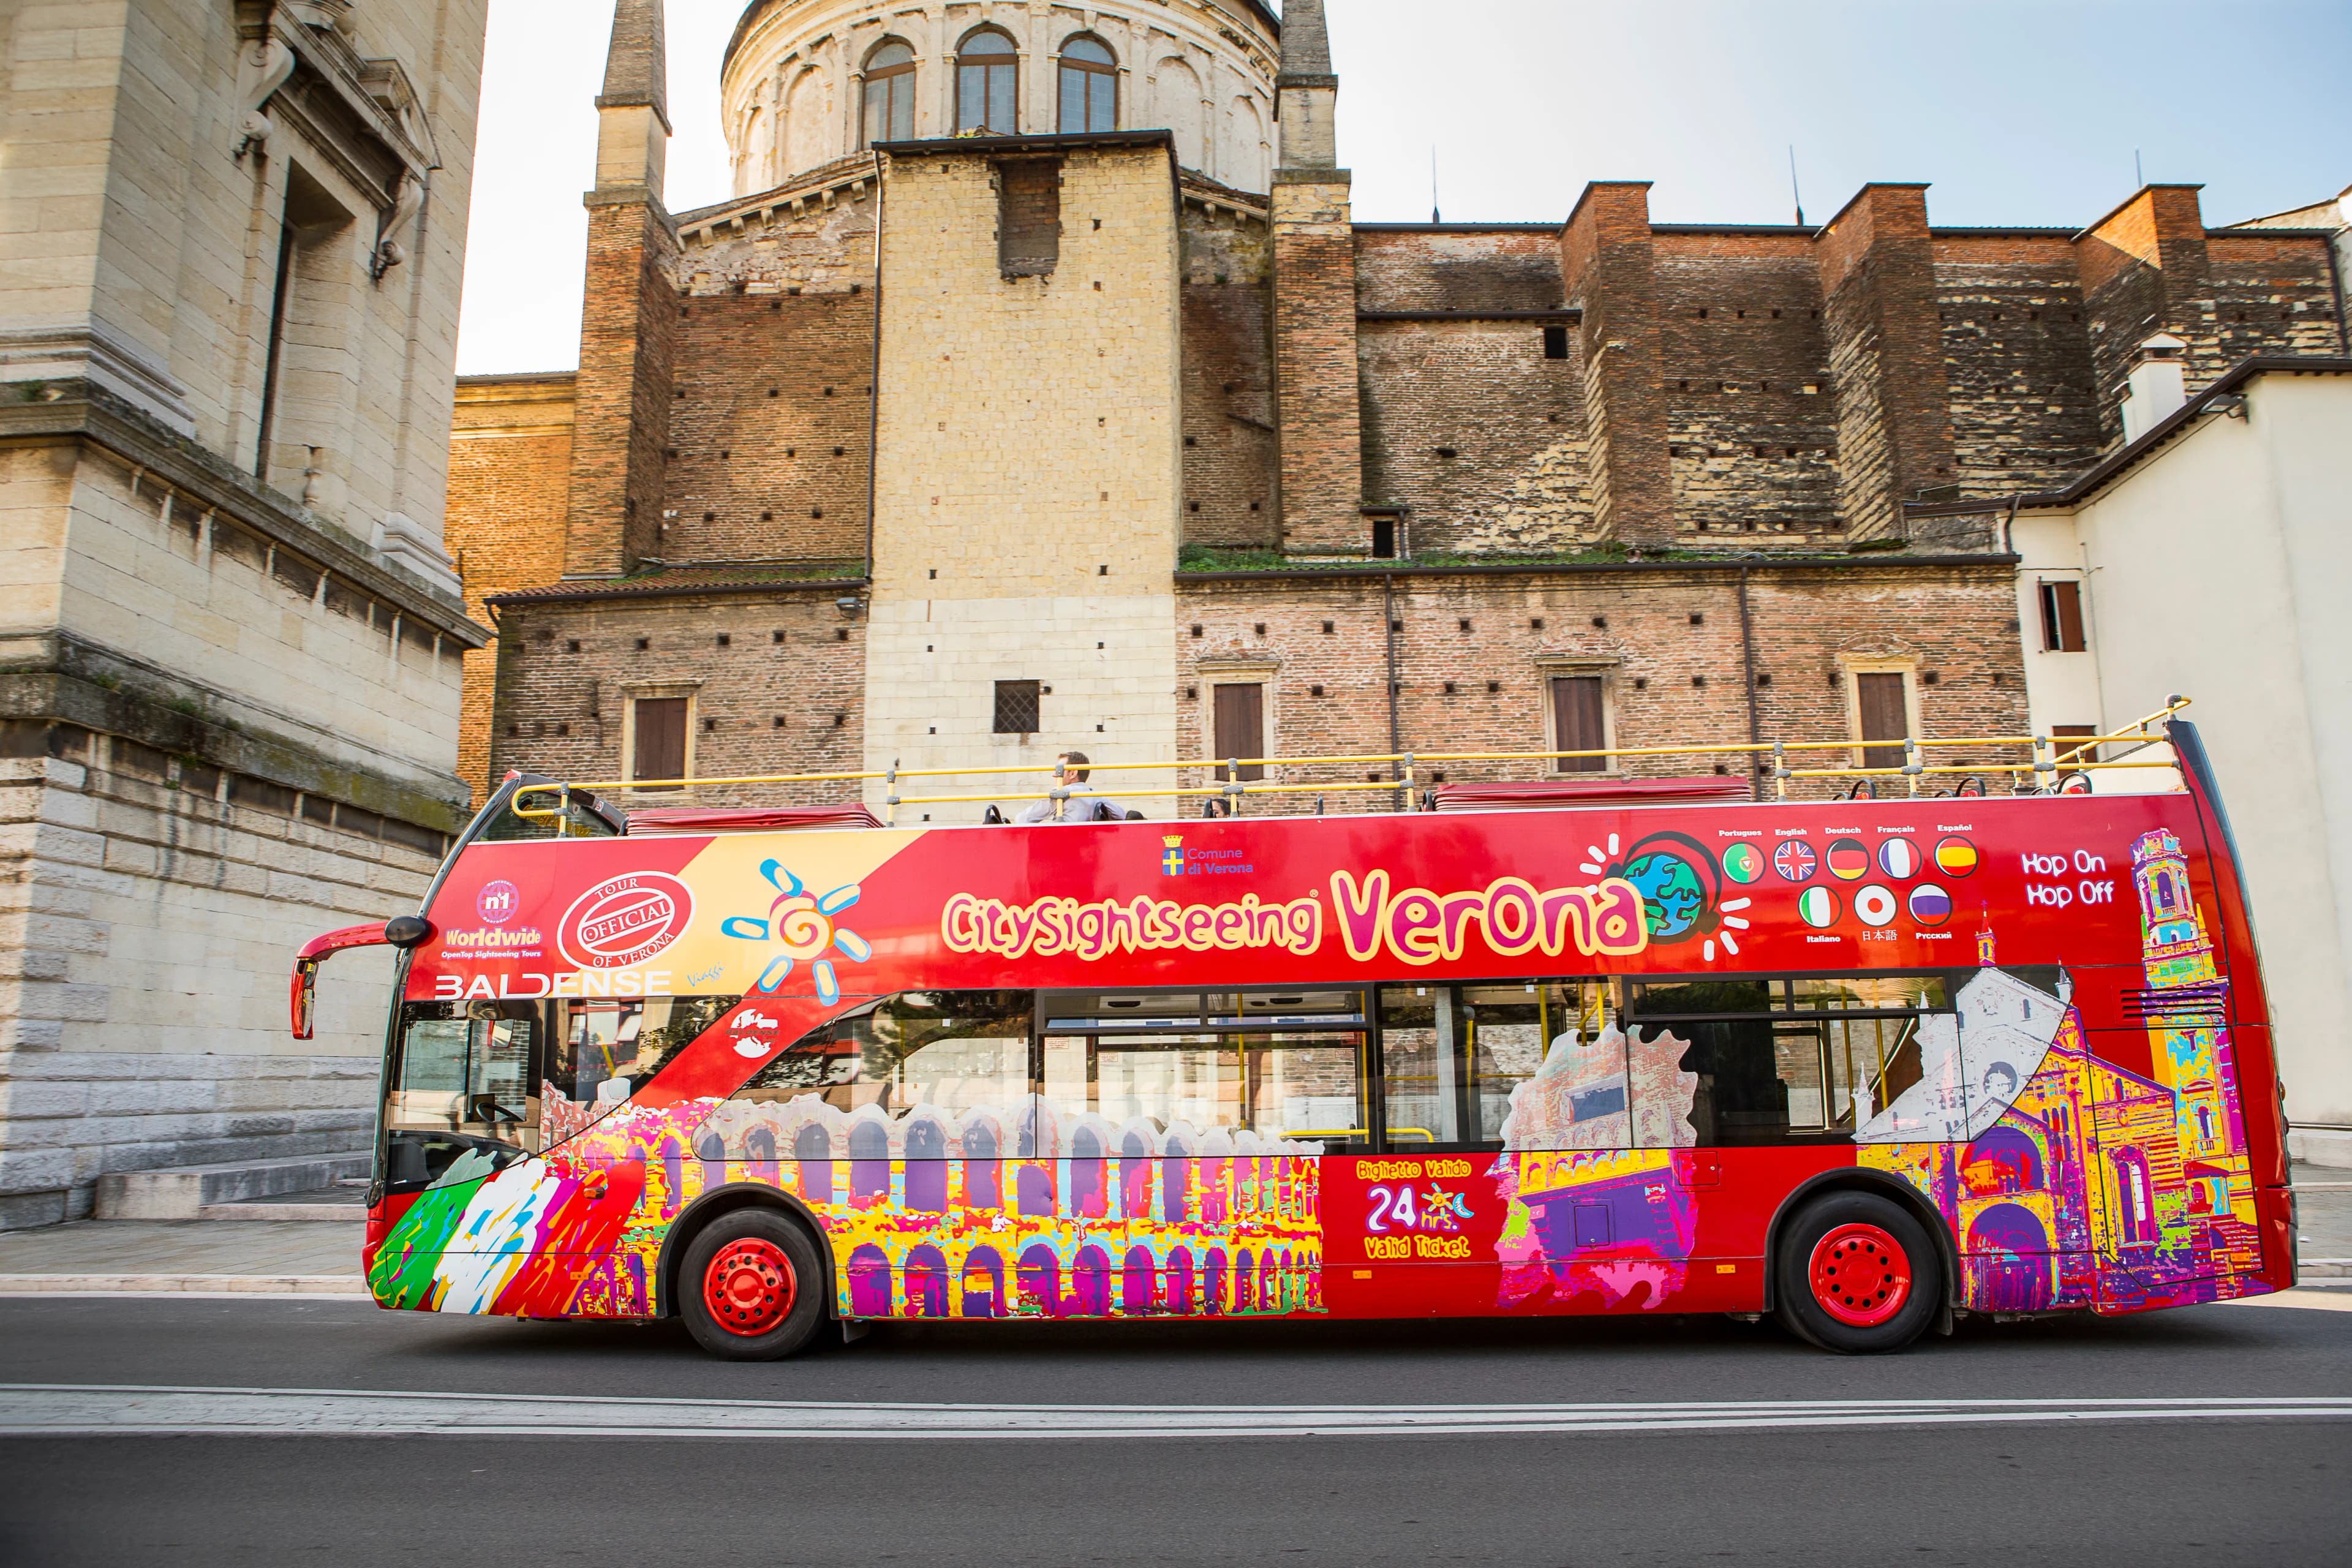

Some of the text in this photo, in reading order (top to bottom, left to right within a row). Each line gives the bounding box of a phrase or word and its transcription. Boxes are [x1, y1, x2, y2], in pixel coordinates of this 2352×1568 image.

[1825, 826, 1861, 835] Deutsch
[1877, 826, 1915, 834] Français
[1937, 824, 1972, 832] Español
[1188, 848, 1243, 860] Comune
[2021, 848, 2106, 877] Hop On
[1188, 862, 1254, 875] di Verona
[595, 877, 639, 900] TOUR
[2026, 880, 2115, 909] Hop Off
[582, 900, 670, 943] OFFICIAL
[1330, 869, 1648, 965] Verona
[445, 927, 541, 947] Worldwide
[1862, 930, 1898, 941] 日本語
[592, 932, 675, 968] OF VERONA
[435, 961, 725, 1000] BALDENSE Viaggi
[1356, 1159, 1472, 1182] Biglietto Valido
[1366, 1185, 1417, 1234] 24
[1364, 1235, 1471, 1259] Valid Ticket
